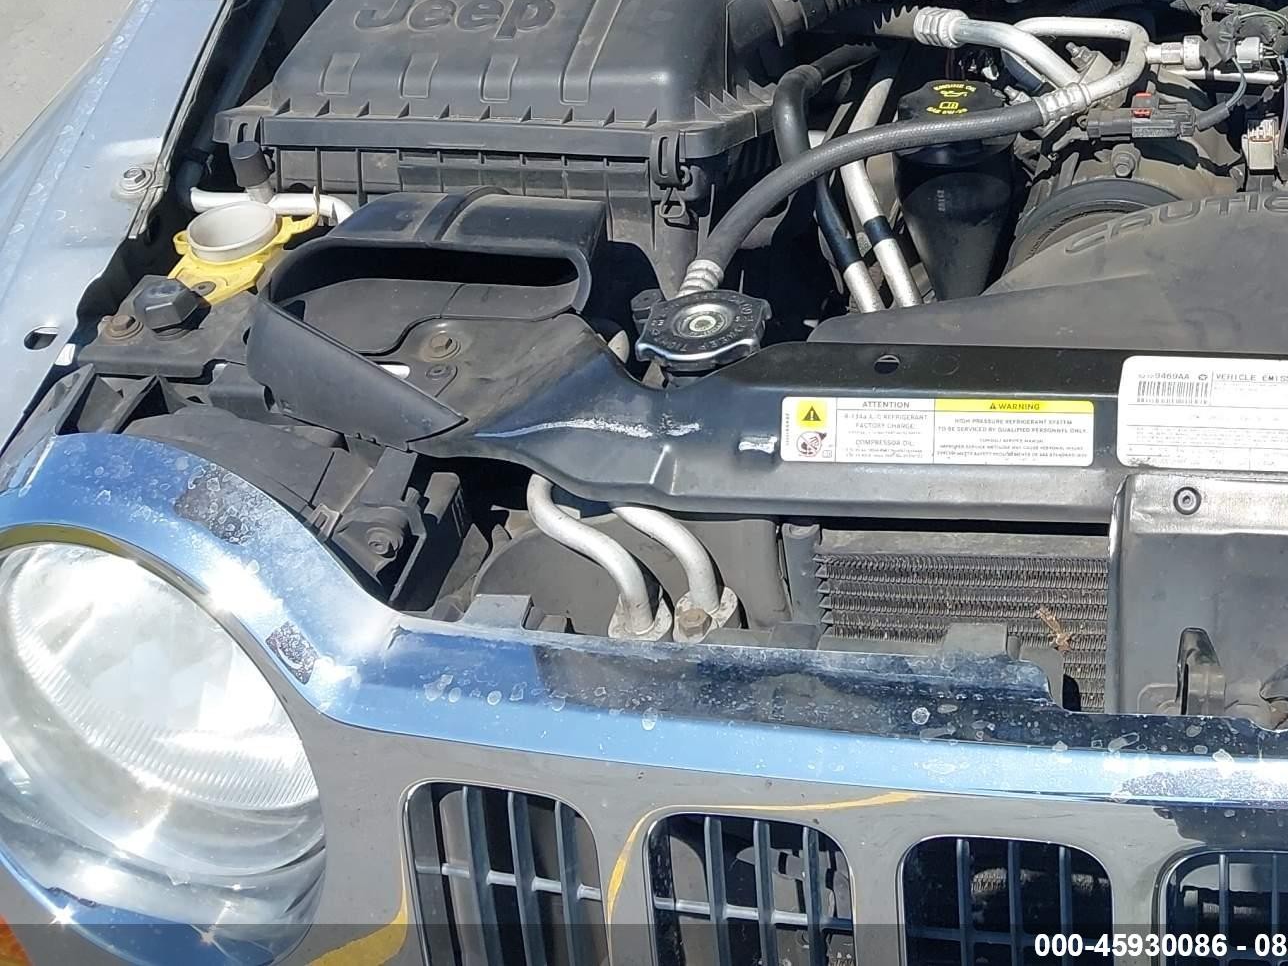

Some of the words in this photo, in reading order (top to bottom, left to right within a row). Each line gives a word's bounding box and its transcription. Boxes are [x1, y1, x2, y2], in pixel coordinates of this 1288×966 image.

[1216, 373, 1257, 381] VEHICLE
[862, 401, 910, 409] ATTENTION
[998, 403, 1041, 411] WARNING
[855, 439, 901, 447] COMPRESSOR
